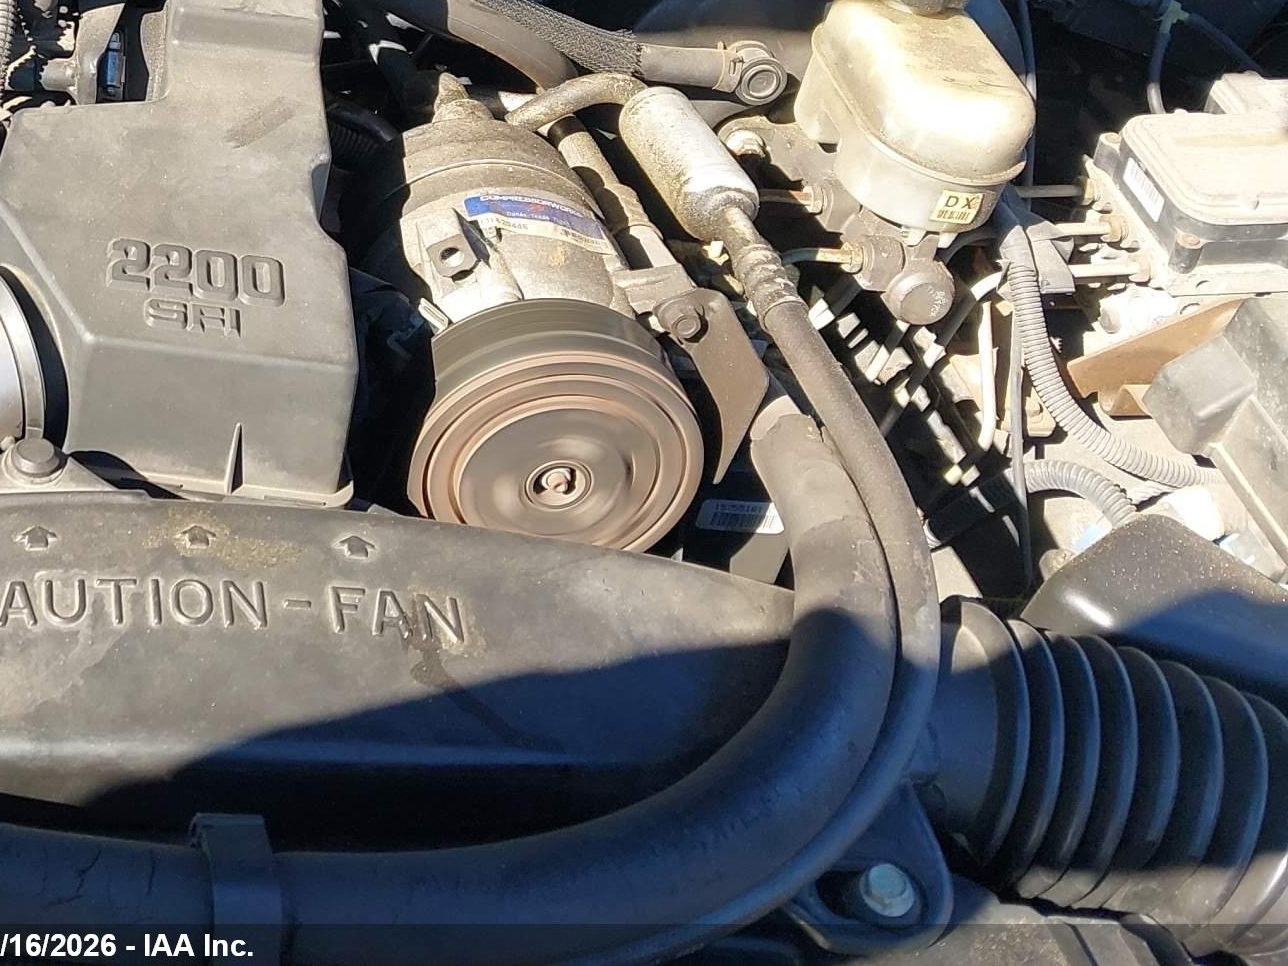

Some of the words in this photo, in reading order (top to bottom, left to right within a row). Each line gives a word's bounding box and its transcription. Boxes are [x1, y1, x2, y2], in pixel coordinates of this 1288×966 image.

[106, 237, 286, 307] 2200
[143, 298, 242, 337] SFI
[329, 584, 467, 645] FAN
